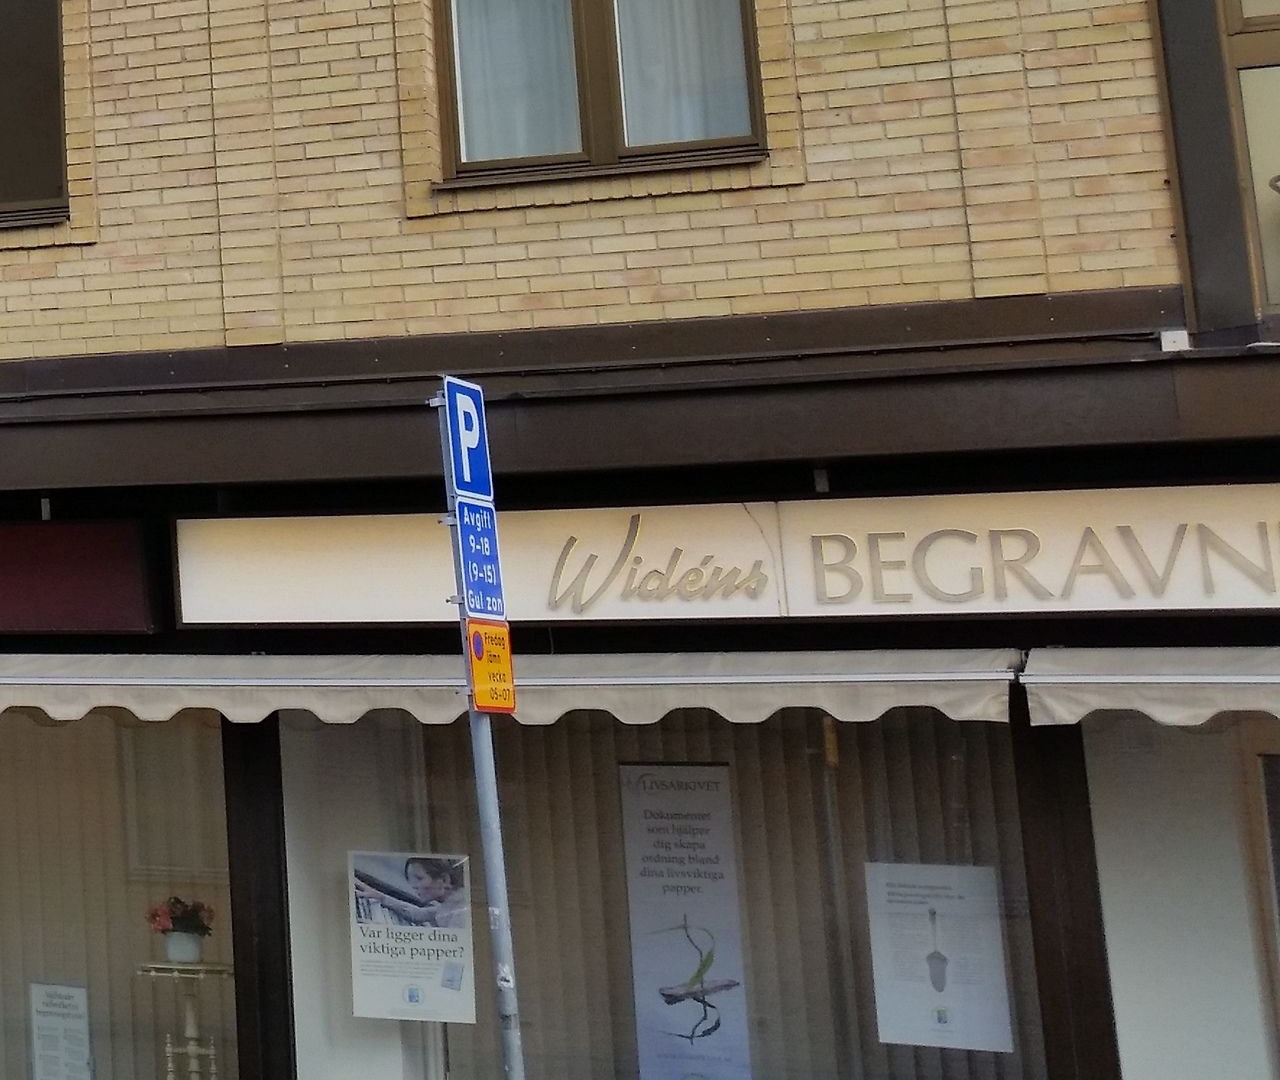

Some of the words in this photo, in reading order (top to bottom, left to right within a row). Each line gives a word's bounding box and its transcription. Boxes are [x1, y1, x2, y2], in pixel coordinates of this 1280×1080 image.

[455, 392, 480, 482] P
[463, 506, 491, 532] Avgift
[469, 534, 491, 556] 9-18
[468, 560, 497, 586] (9-15)
[548, 513, 769, 614] Widéns
[809, 520, 1280, 606] BEGRAVN
[468, 589, 484, 610] Gul
[486, 597, 503, 612] zon
[359, 926, 383, 939] Var
[386, 927, 424, 943] ligger
[428, 930, 458, 943] dina
[359, 942, 406, 957] viktiga
[410, 945, 465, 961] papper?
